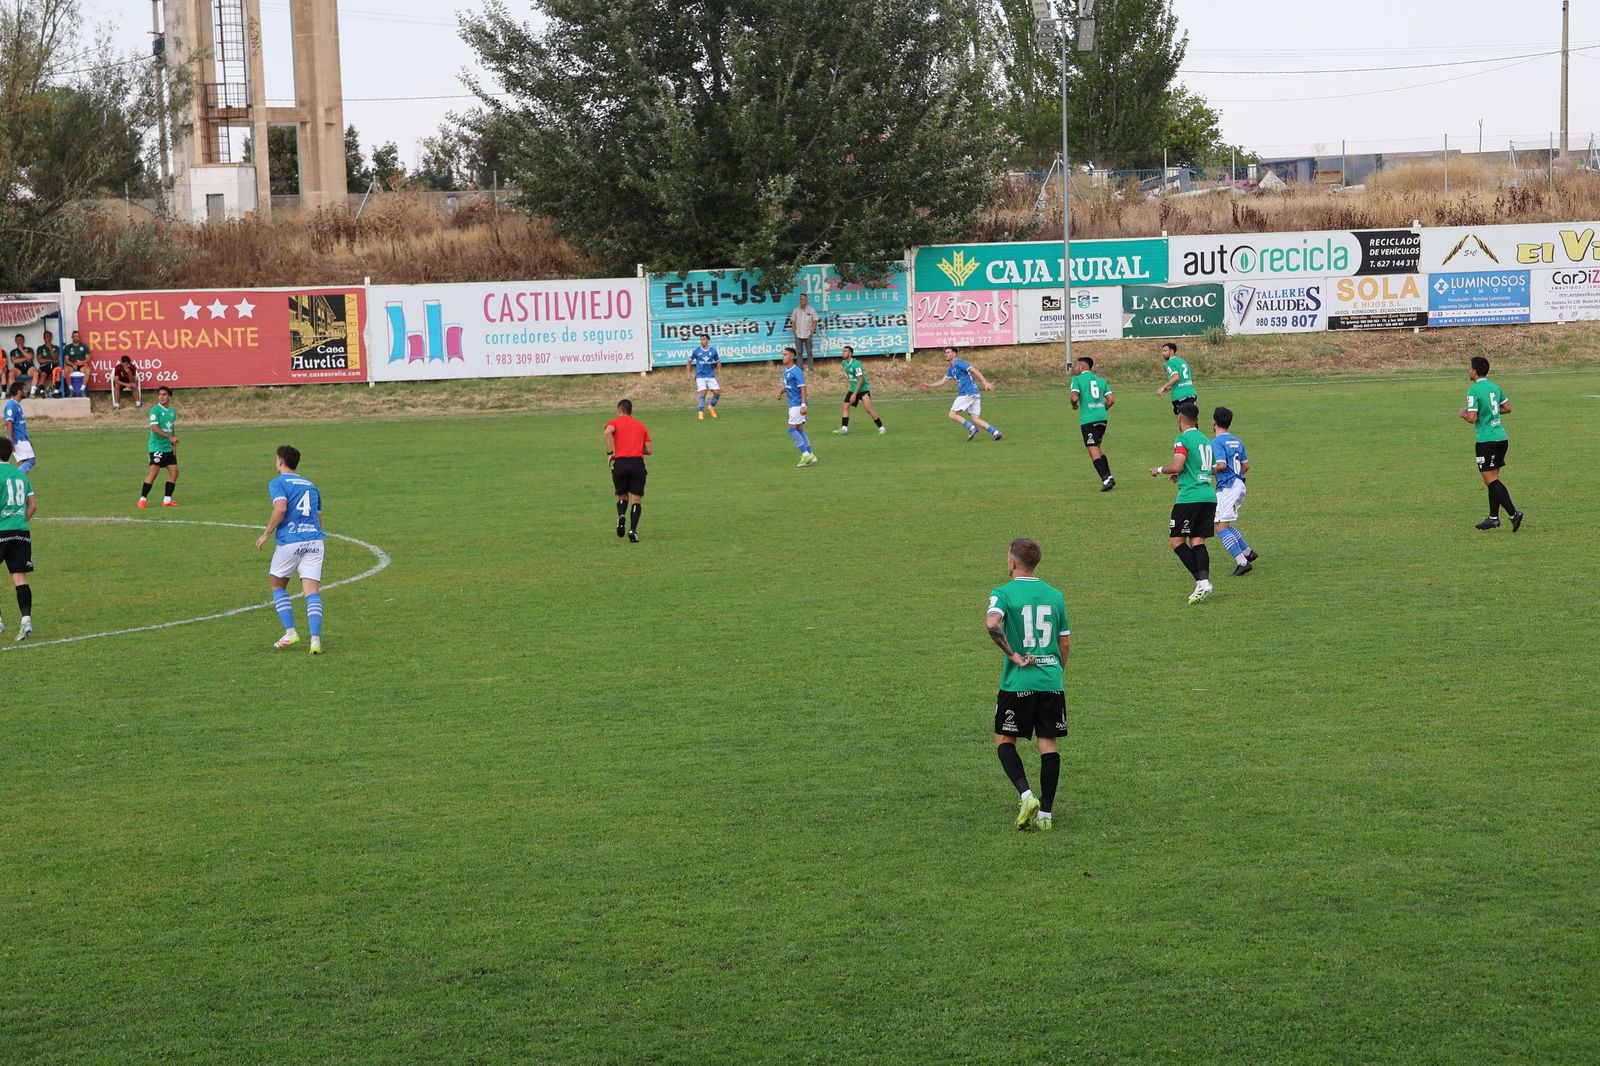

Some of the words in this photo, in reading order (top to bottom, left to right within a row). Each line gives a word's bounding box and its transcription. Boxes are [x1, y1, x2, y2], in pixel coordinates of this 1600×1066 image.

[1369, 237, 1420, 247] RECICLADO
[1369, 248, 1380, 256] DE
[1380, 246, 1420, 256] VEHÍCULOS
[985, 259, 1053, 285] CAJA
[1057, 255, 1150, 282] RURAL
[1369, 260, 1376, 268] T.
[1392, 259, 1405, 267] 144
[1405, 259, 1419, 267] 311
[1336, 275, 1420, 302] SOLA
[1451, 275, 1526, 289] LUMINOSOS
[1451, 287, 1526, 295] ZAMORA
[1256, 286, 1321, 301] TALLERES
[1256, 290, 1321, 312] SALUDES
[87, 298, 165, 322] HOTEL
[483, 289, 632, 323] CASTILVIEJO
[1040, 313, 1085, 322] CASQUIAS
[1086, 312, 1102, 320] SUSI
[1144, 314, 1205, 325] CAFE&POOL
[1256, 317, 1269, 327] 980
[1270, 316, 1288, 327] 539
[1291, 314, 1318, 328] 807
[485, 327, 556, 345] corredores
[562, 325, 577, 343] de
[582, 327, 634, 345] seguros
[766, 319, 776, 337] y
[89, 326, 259, 351] RESTAURANTE
[317, 345, 345, 354] Casa
[486, 354, 494, 365] T.
[496, 353, 512, 365] 983
[516, 352, 533, 364] 309
[535, 352, 551, 364] 807
[559, 350, 635, 364] www.castilviejo.es
[156, 370, 179, 382] 626
[1090, 380, 1100, 399] 6
[1489, 391, 1499, 416] 5
[1233, 452, 1242, 476] 6
[6, 478, 26, 507] 18
[296, 489, 312, 517] 4
[1020, 604, 1053, 648] 15
